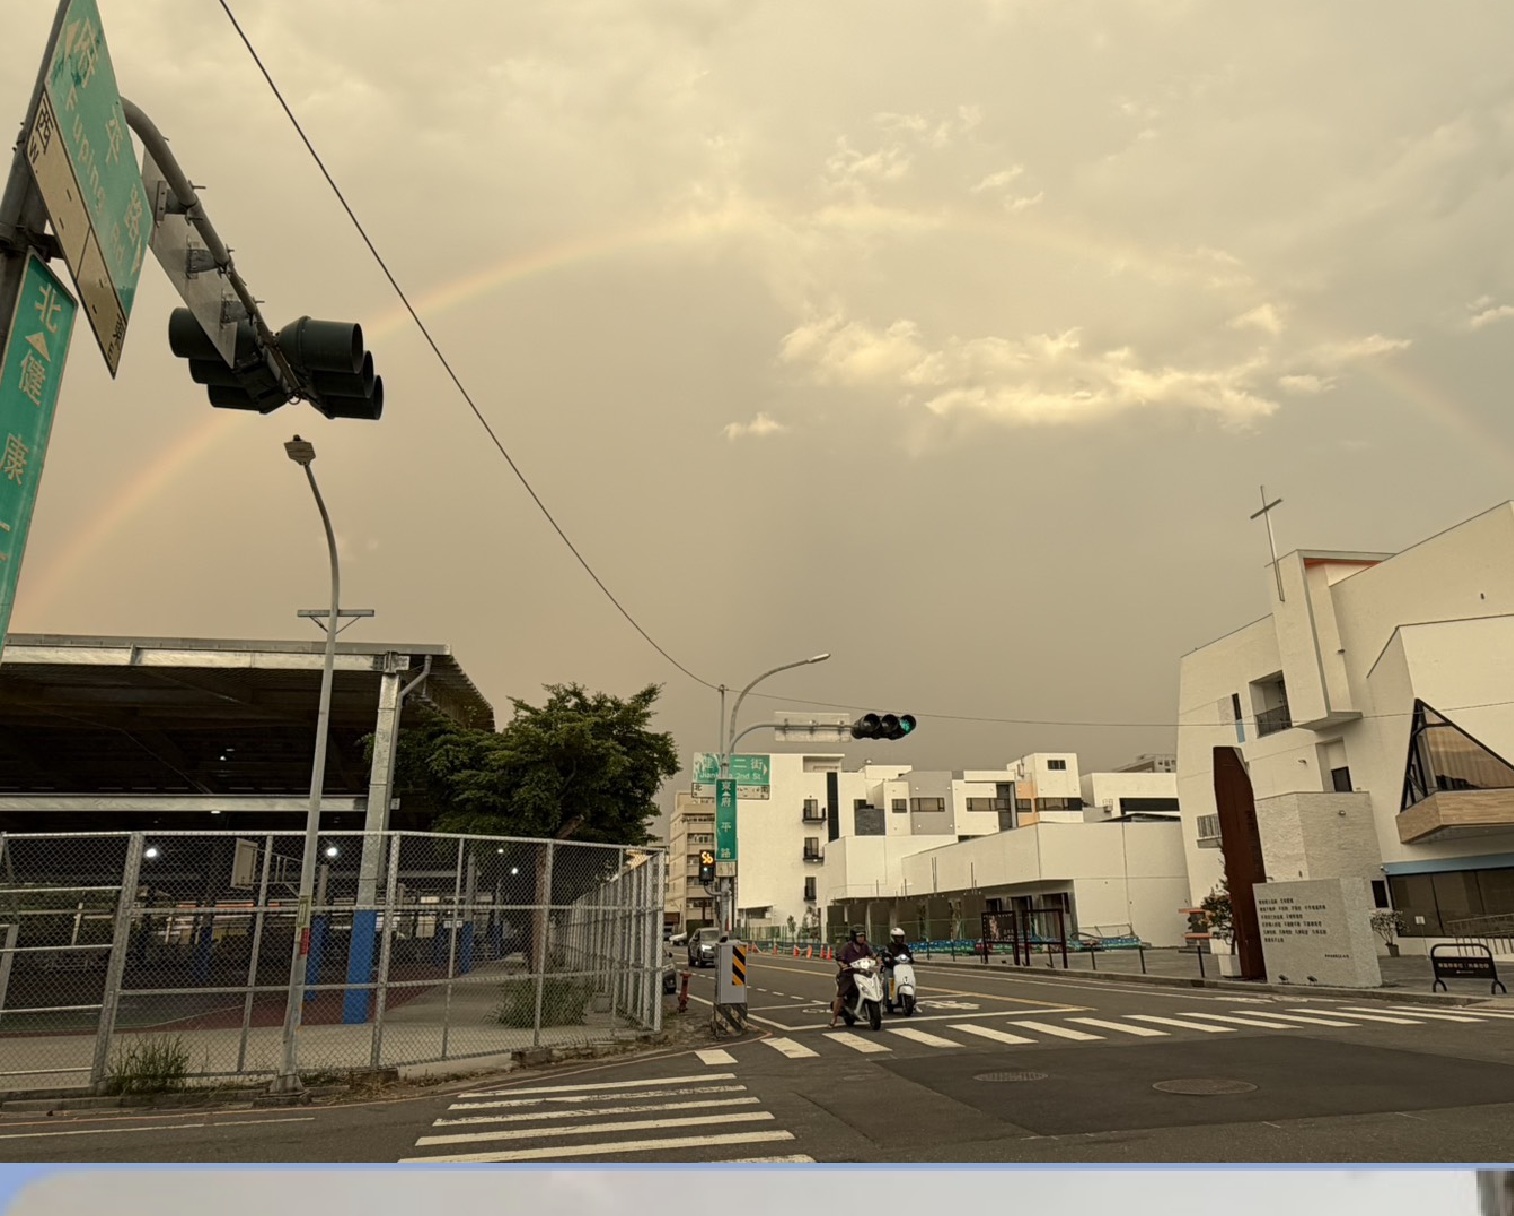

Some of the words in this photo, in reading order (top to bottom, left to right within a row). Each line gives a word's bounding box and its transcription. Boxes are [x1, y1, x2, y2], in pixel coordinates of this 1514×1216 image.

[36, 97, 54, 155] 西
[66, 86, 107, 213] Fuping
[34, 283, 61, 333] 北
[702, 851, 713, 864] 56
